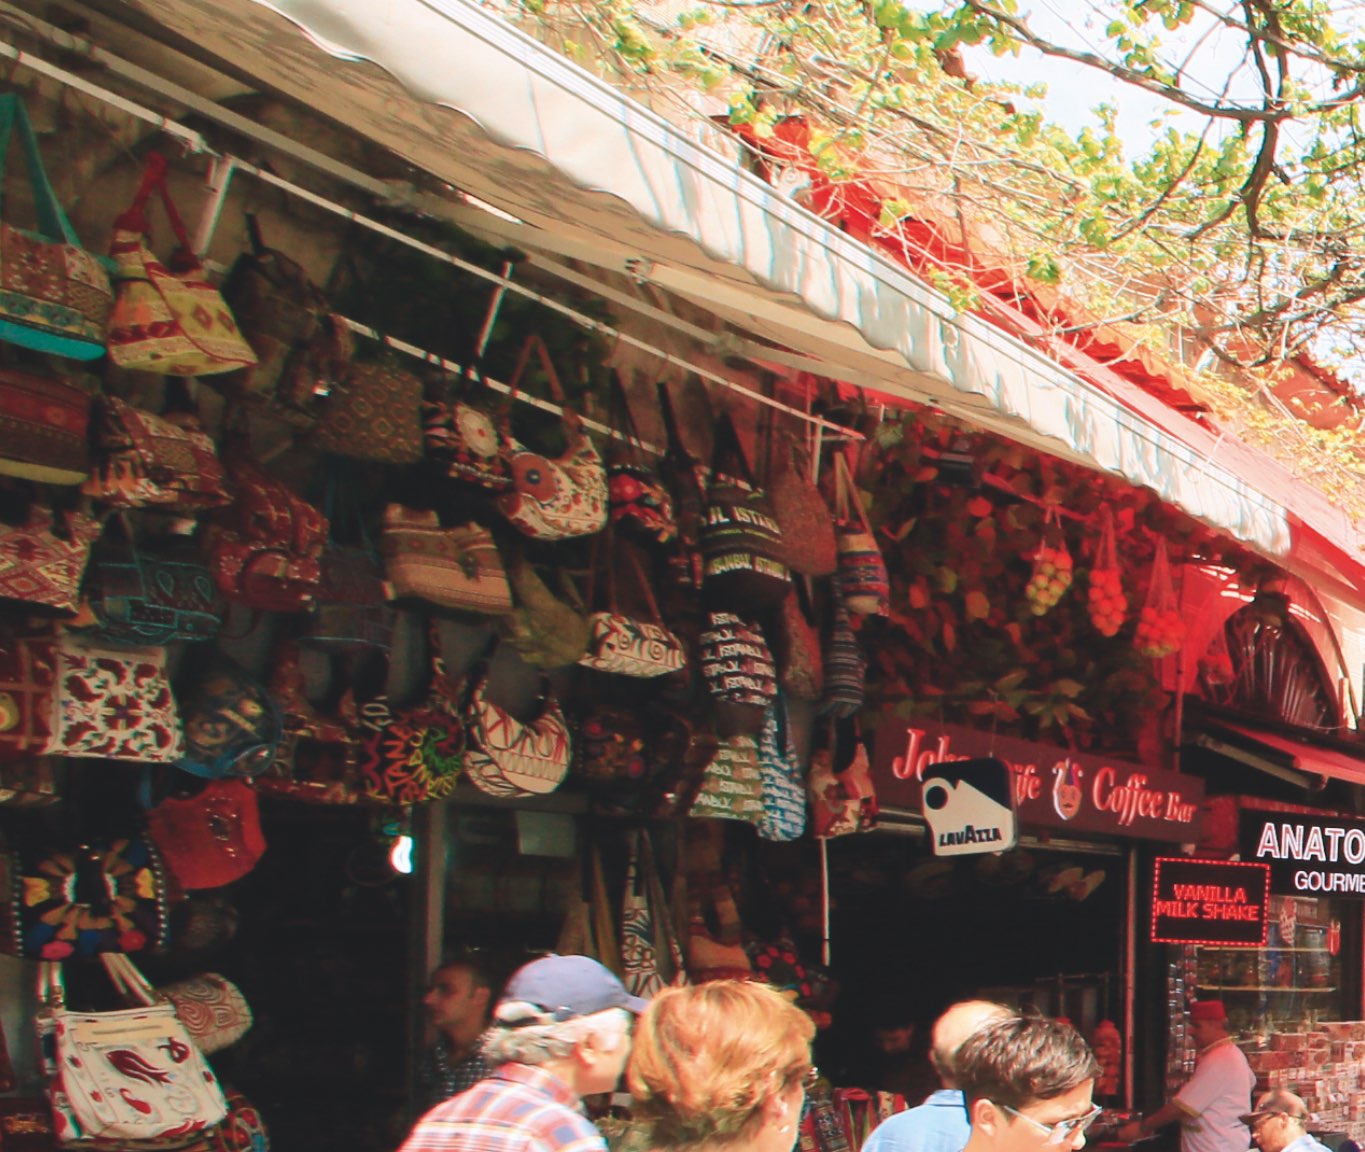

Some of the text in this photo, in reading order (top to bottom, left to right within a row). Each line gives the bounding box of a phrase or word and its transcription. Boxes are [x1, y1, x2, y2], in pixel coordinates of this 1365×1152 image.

[1092, 767, 1163, 827] Coffee
[1166, 792, 1198, 823] Bar
[939, 825, 1003, 847] LAVAZZA
[1173, 884, 1248, 903] VANILLA
[1156, 901, 1260, 921] MILK SHAKE
